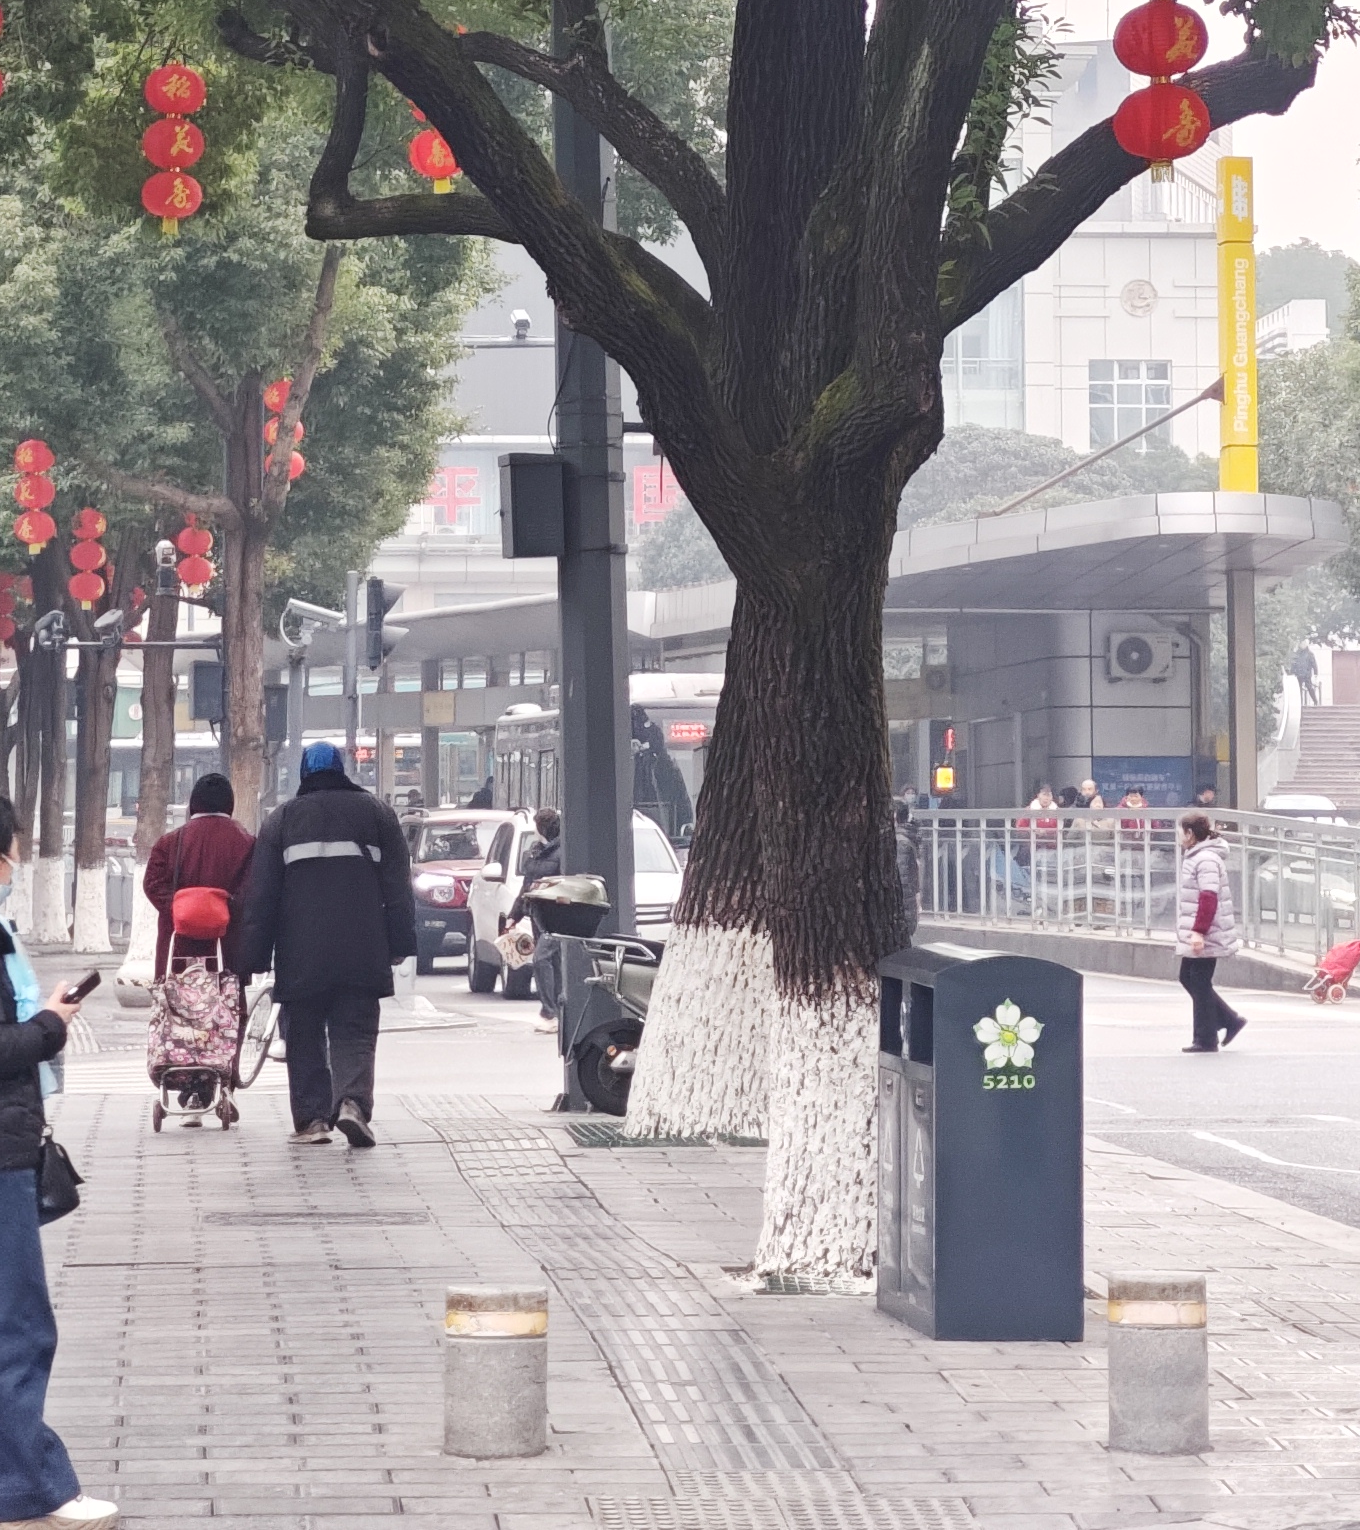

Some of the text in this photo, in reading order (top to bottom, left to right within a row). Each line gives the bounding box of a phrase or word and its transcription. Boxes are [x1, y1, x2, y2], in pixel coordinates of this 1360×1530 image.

[1233, 257, 1250, 433] Pinghu Guangchang
[982, 1074, 1036, 1090] 5210
